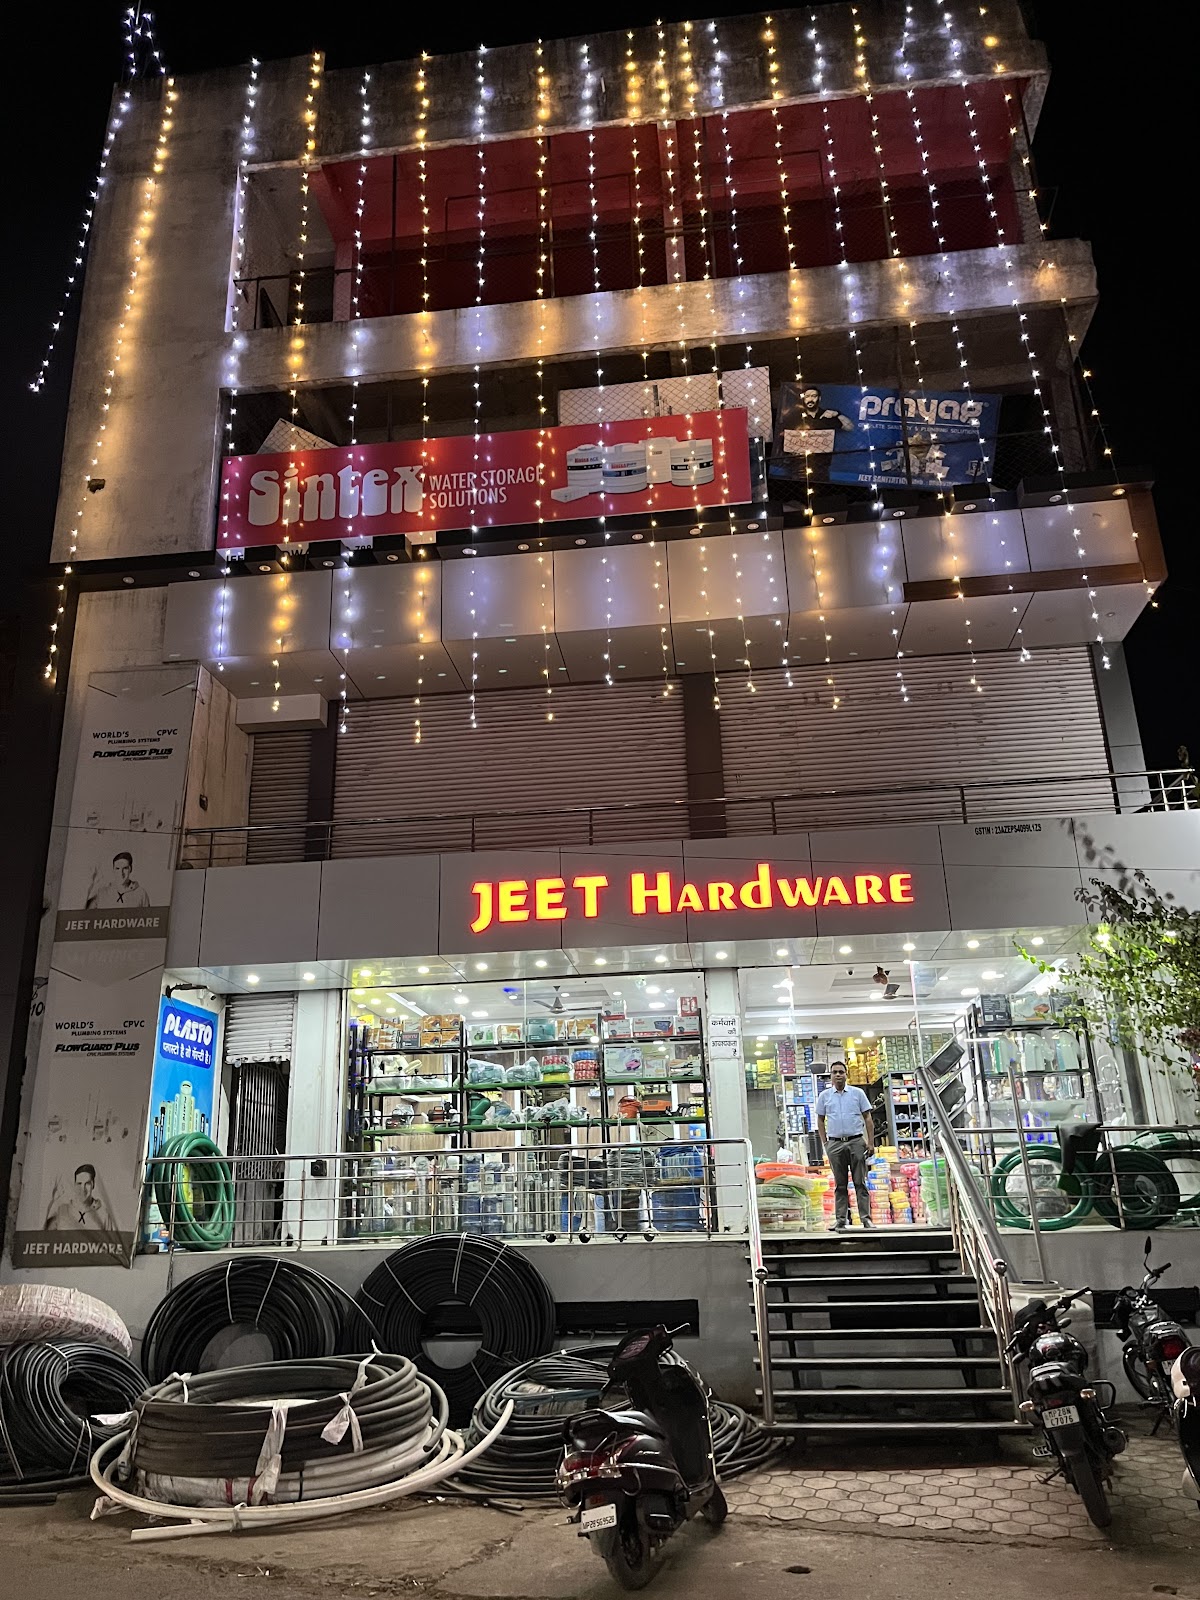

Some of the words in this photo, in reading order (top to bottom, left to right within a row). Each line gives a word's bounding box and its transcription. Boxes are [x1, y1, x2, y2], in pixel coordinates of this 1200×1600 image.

[859, 396, 983, 427] prayag
[429, 472, 476, 491] WATER
[481, 466, 543, 487] STORAGE
[247, 465, 423, 526] Sintex
[429, 487, 507, 509] SOLUTIONS
[92, 731, 130, 739] WORLD'S
[157, 728, 178, 736] CPVC
[470, 875, 609, 933] JEET
[65, 920, 91, 931] JEET
[93, 917, 160, 930] HARDWARE
[55, 1021, 94, 1030] WORLD'S
[123, 1020, 145, 1028] CPVC
[163, 1013, 213, 1046] PLASTO
[22, 1243, 50, 1255] JEET
[53, 1242, 123, 1255] HARDWARE
